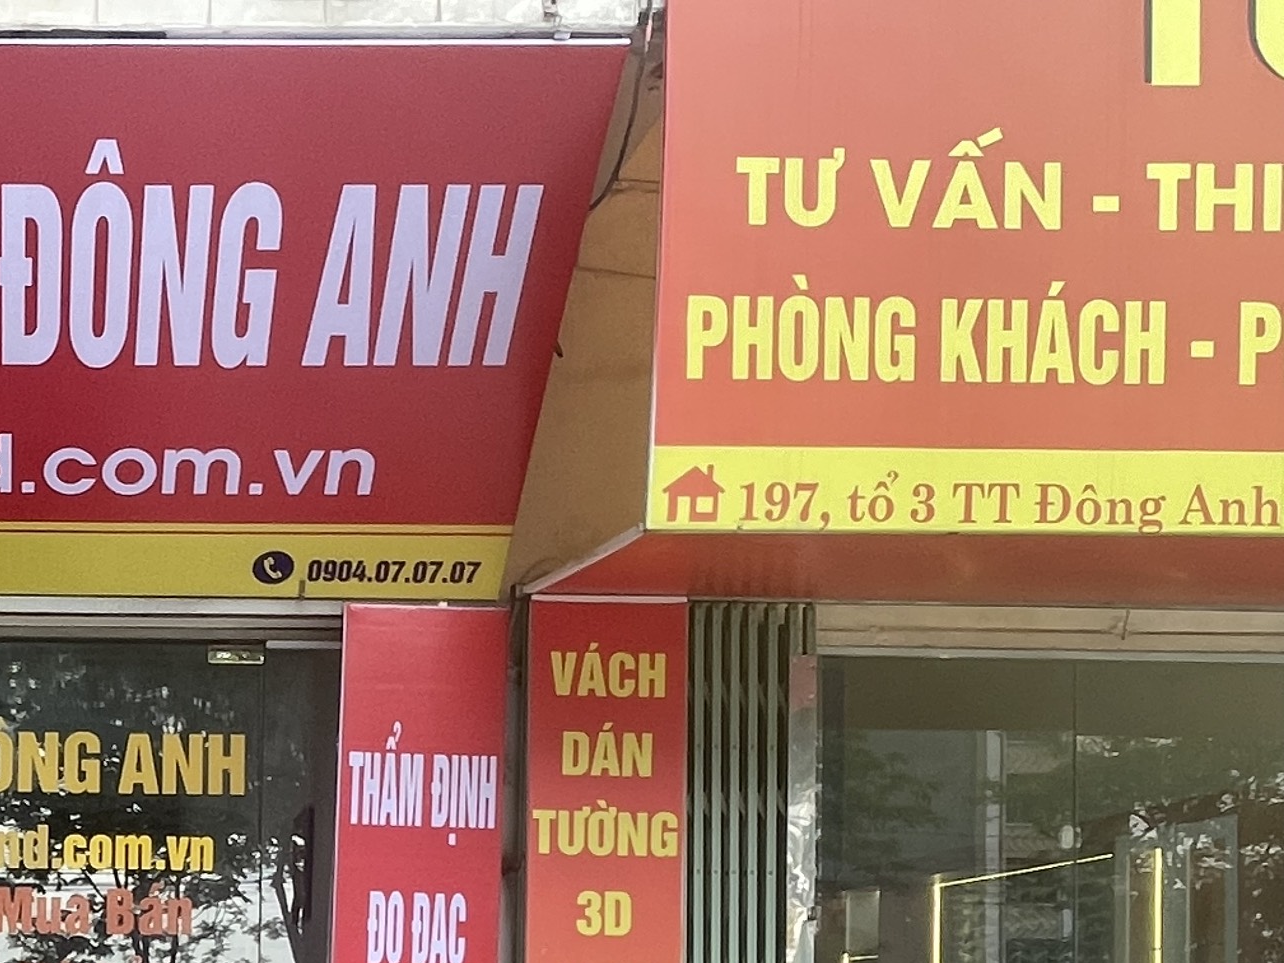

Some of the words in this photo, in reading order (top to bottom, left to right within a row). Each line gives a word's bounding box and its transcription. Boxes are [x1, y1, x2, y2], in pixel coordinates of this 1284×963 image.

[736, 147, 846, 227] TƯ
[870, 127, 1063, 230] VẤN
[1146, 163, 1283, 231] THI
[302, 184, 544, 367] ANH
[685, 273, 916, 382] PHÒNG
[940, 280, 1167, 385] KHÁCH
[1238, 301, 1282, 385] P
[738, 482, 831, 531] 197,
[847, 470, 900, 523] tổ
[910, 483, 936, 524] 3
[952, 483, 1020, 524] TT
[1035, 482, 1167, 533] Đông
[1178, 484, 1281, 528] Anh
[307, 559, 482, 584] 0904.07.07.07
[550, 642, 667, 698] VÁCH
[117, 733, 247, 796] ANH
[561, 722, 653, 777] DÁN
[348, 721, 424, 827] THẨM
[431, 754, 497, 846] ĐỊNH
[532, 799, 679, 857] TƯỜNG
[106, 882, 193, 936] Bán
[576, 890, 632, 936] 3D
